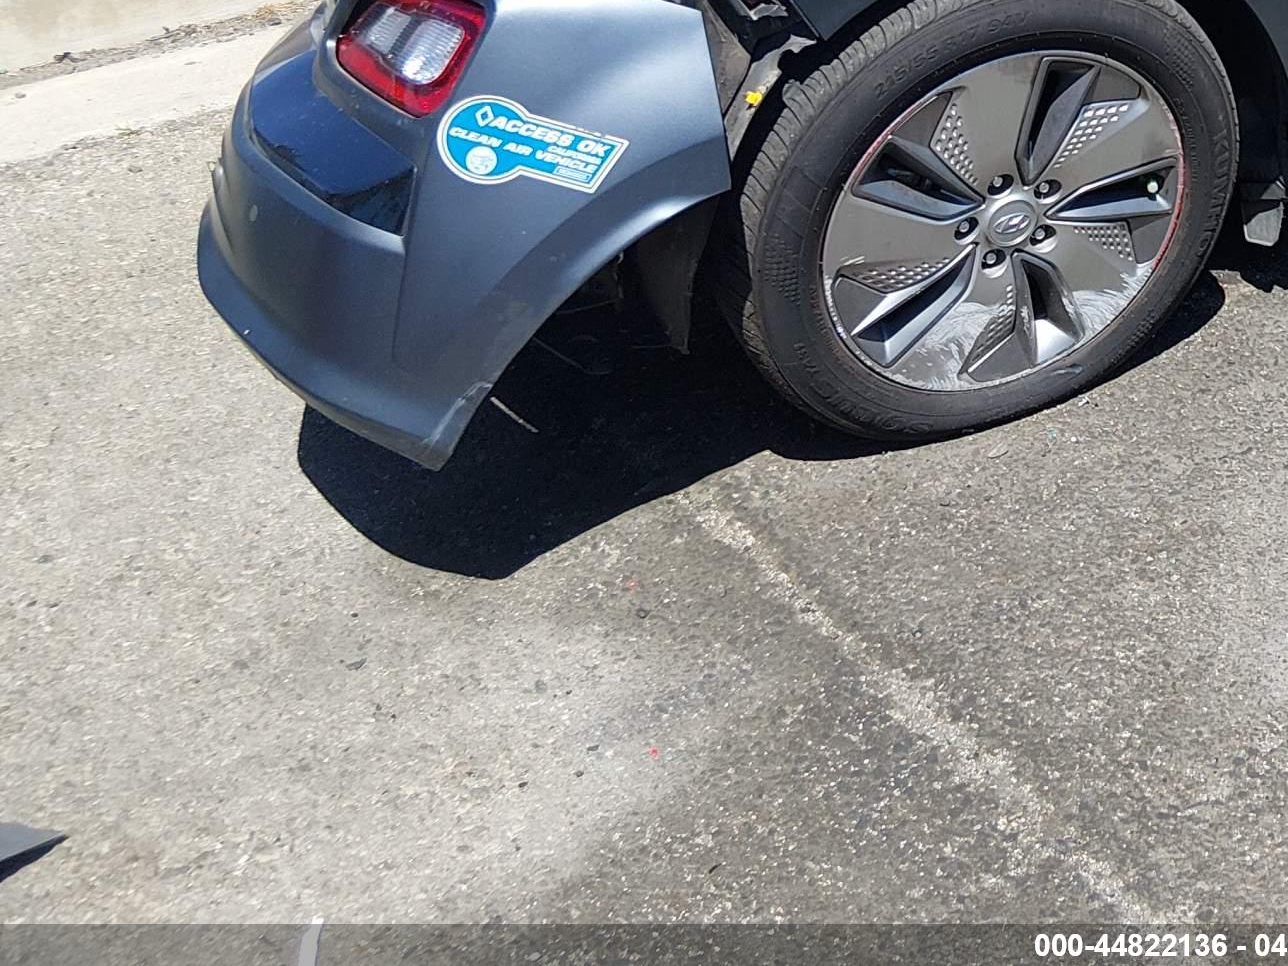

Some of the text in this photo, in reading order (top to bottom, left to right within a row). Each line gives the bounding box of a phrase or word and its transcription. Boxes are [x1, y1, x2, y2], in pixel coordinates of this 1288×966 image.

[449, 127, 599, 173] CLEAN AIR VEHICLE
[489, 116, 612, 158] ACCESS OK
